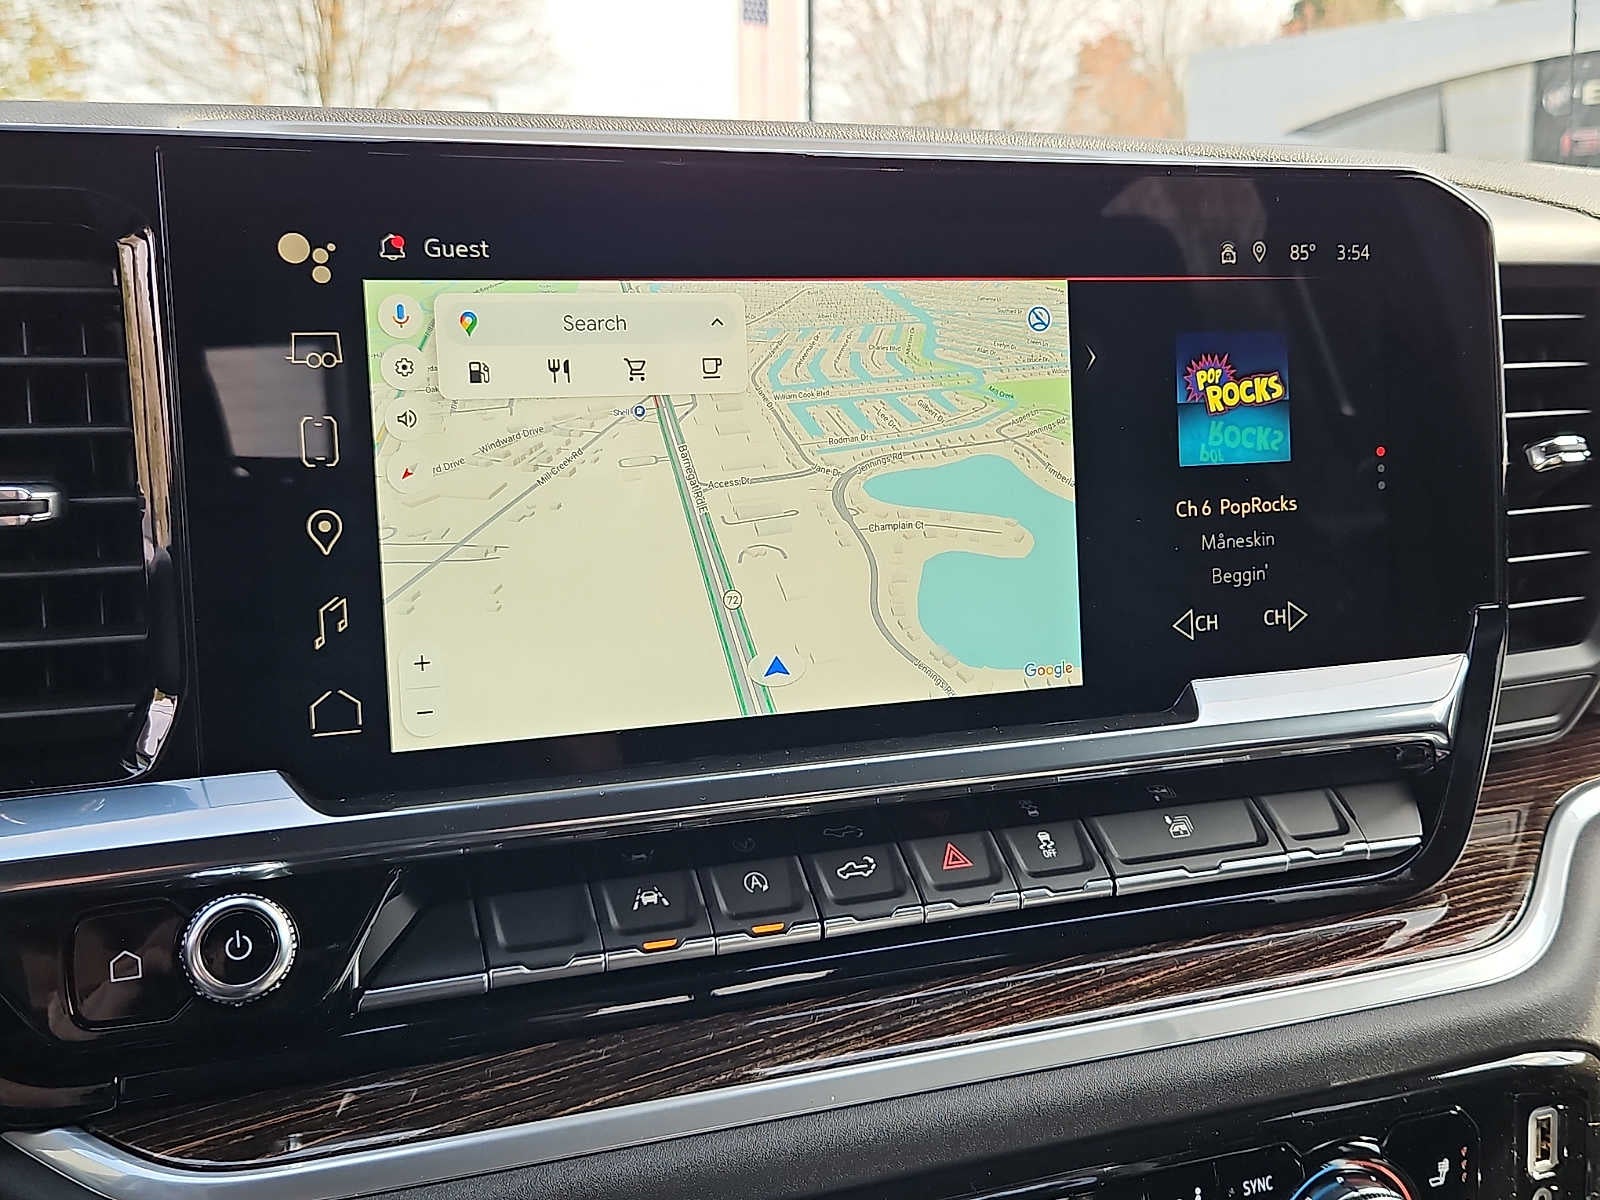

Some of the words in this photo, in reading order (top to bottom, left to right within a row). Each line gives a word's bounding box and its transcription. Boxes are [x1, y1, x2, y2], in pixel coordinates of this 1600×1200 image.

[423, 238, 491, 259] Guest
[1336, 243, 1370, 261] 3:54
[562, 314, 627, 332] Search
[1196, 367, 1222, 391] POP
[756, 386, 768, 402] Jane
[773, 393, 798, 401] William
[798, 391, 815, 400] Cook
[1206, 374, 1284, 413] ROCKS
[613, 410, 630, 418] Shell
[876, 408, 889, 421] Lee
[917, 399, 940, 419] Gilbert
[1011, 414, 1030, 427] Aspen
[1030, 409, 1039, 417] Ln
[1026, 424, 1057, 438] Jennings
[1056, 416, 1066, 426] Rd
[479, 434, 521, 455] Windward
[522, 425, 544, 438] Drive
[829, 436, 858, 445] Rodman
[860, 433, 869, 441] Dr
[443, 456, 466, 472] Drive
[537, 470, 554, 487] Mill
[550, 456, 574, 476] Creek
[679, 445, 701, 491] Barnegat
[813, 463, 831, 474] Jane
[832, 468, 842, 477] Dr
[857, 453, 891, 475] Jennings
[892, 452, 903, 460] Rd
[708, 480, 739, 489] Access
[1176, 500, 1198, 517] Ch
[1201, 500, 1212, 516] 6
[1220, 495, 1297, 518] PopRocks
[868, 521, 913, 532] Champlain
[915, 520, 924, 529] Ct
[1201, 530, 1275, 551] Måneskin
[1212, 563, 1268, 587] Beggin'
[727, 595, 739, 605] 72
[1195, 614, 1219, 631] CH
[1263, 608, 1286, 626] CH
[914, 658, 949, 690] Jennings
[1024, 661, 1073, 678] Google
[1242, 1175, 1274, 1197] SYNC
